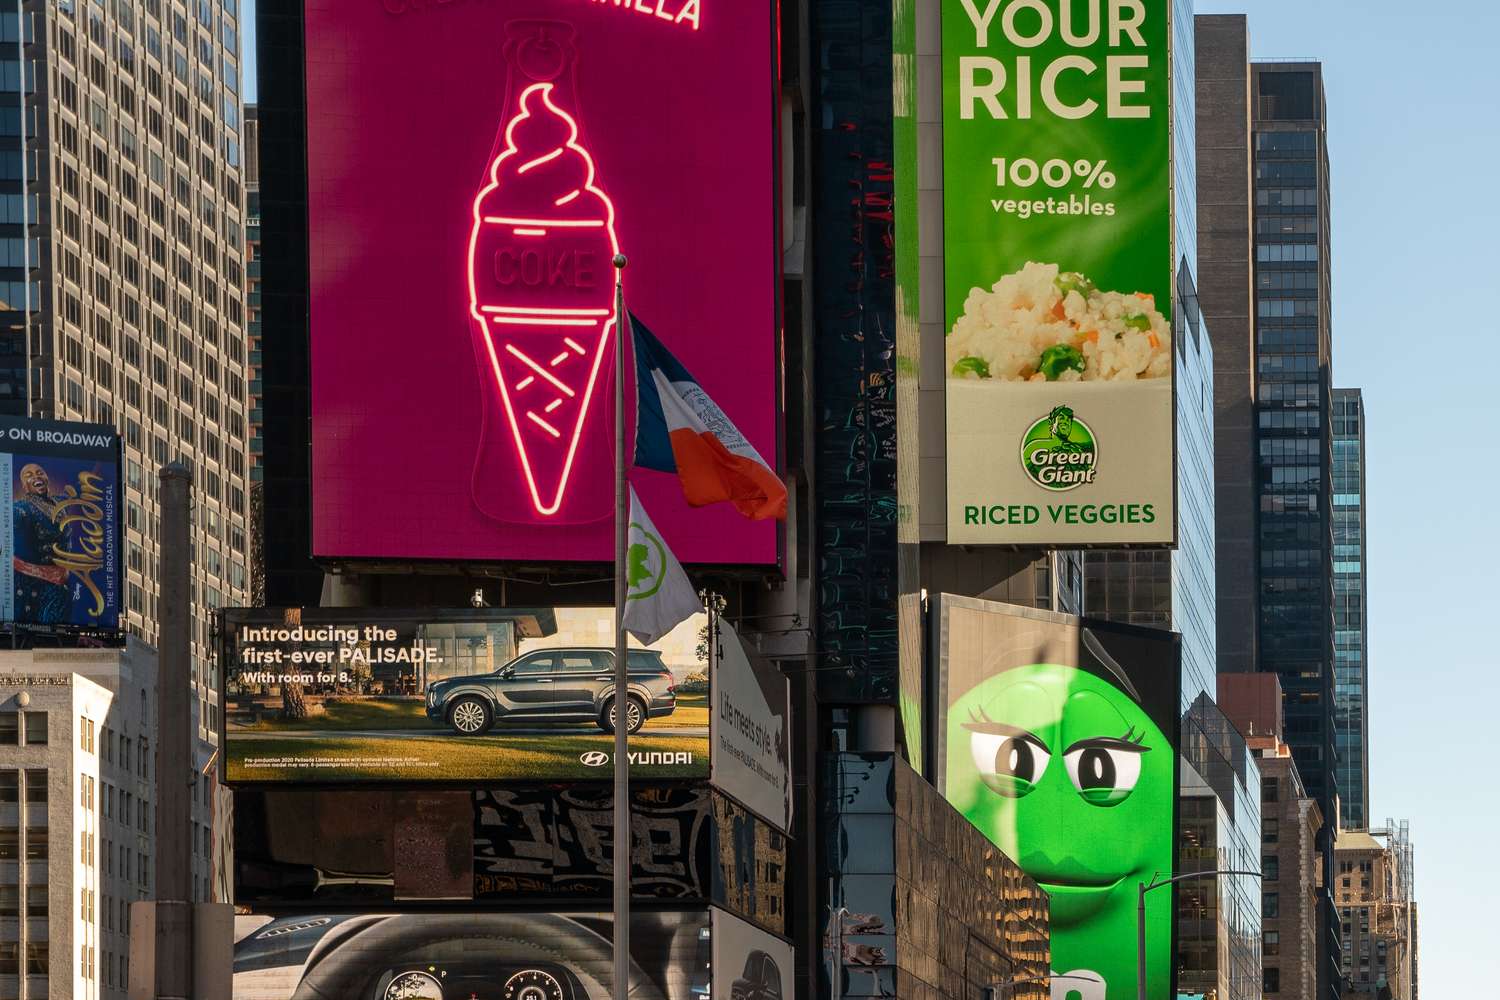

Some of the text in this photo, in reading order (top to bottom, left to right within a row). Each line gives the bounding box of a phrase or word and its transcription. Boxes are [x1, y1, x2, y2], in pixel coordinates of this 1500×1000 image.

[961, 0, 1147, 49] YOUR
[959, 55, 1151, 120] RICE
[992, 156, 1116, 190] 100%
[991, 194, 1116, 219] vegetables
[494, 247, 597, 290] COKE
[9, 428, 112, 448] ON BROADWAY
[1029, 447, 1094, 467] Green
[1037, 464, 1096, 486] Giant
[963, 503, 1156, 526] RICED VEGGIES
[52, 470, 105, 617] Aladdin
[243, 625, 397, 645] Introducing the
[243, 648, 443, 664] first-ever PALISADE.
[243, 671, 352, 684] With room for 8.
[720, 690, 734, 726] Life
[733, 708, 756, 743] meets
[613, 751, 693, 765] YUNDAI
